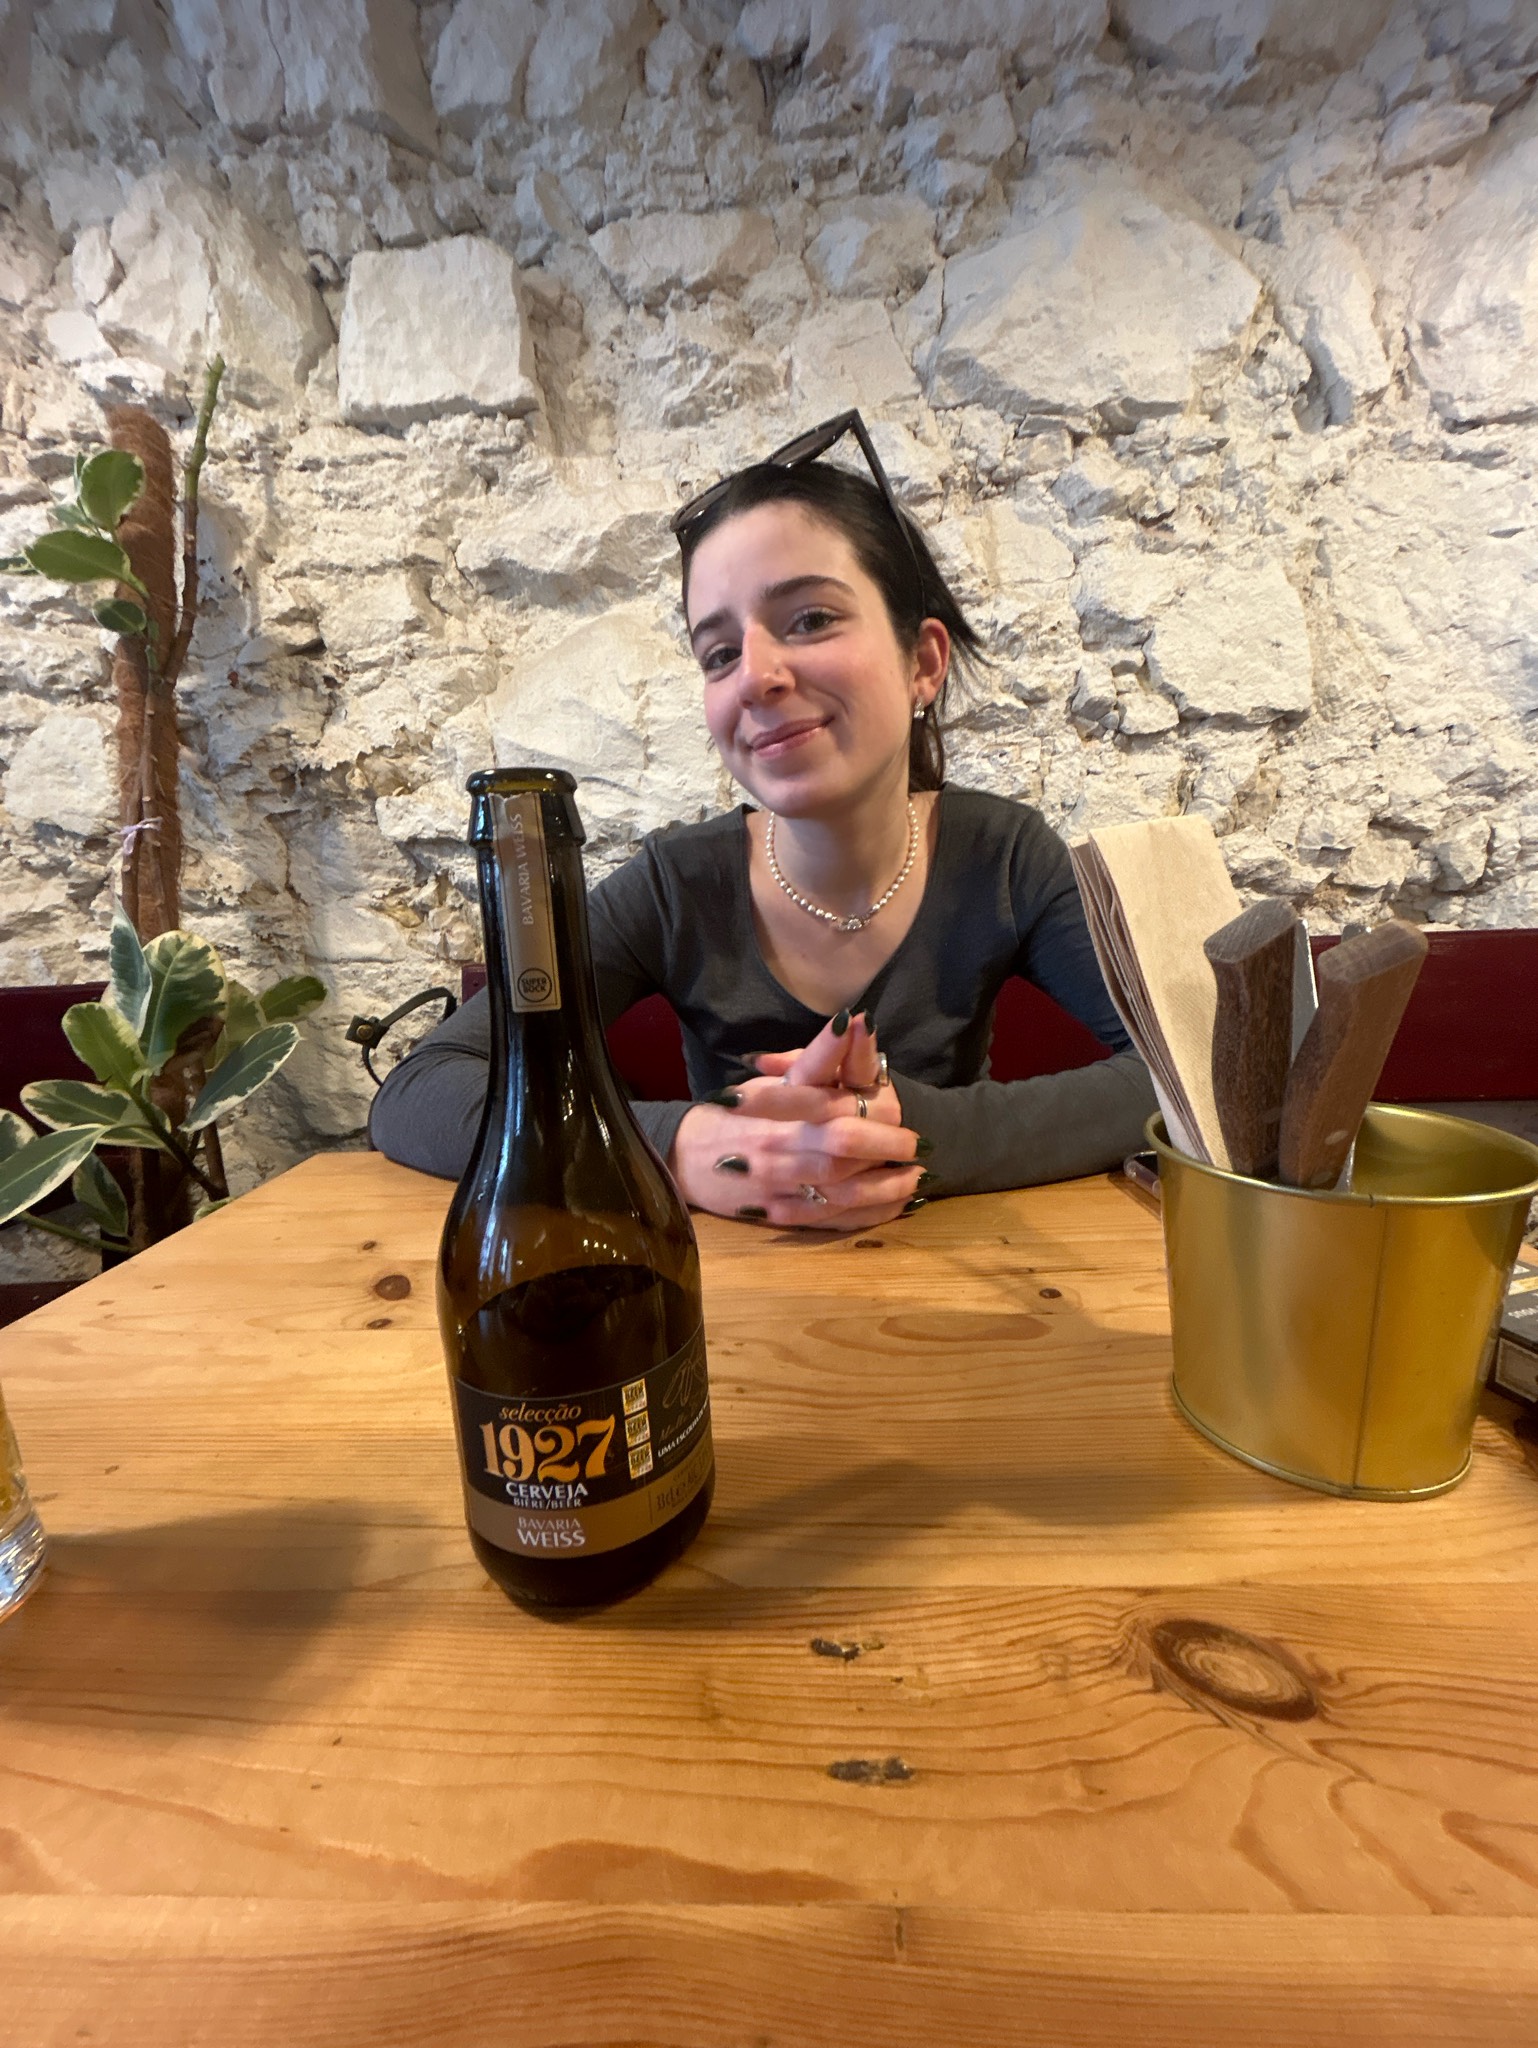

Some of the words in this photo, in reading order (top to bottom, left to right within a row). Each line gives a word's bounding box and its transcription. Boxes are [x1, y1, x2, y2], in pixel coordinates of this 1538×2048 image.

[510, 813, 527, 860] WEISS
[518, 862, 534, 925] BAVARIA
[521, 977, 547, 985] SUPER
[523, 985, 546, 993] BOCK
[499, 1403, 582, 1424] selecção
[478, 1414, 616, 1483] 1927
[505, 1482, 589, 1500] CERVEJA
[518, 1516, 581, 1530] BAVARIA
[516, 1529, 586, 1547] WEISS
